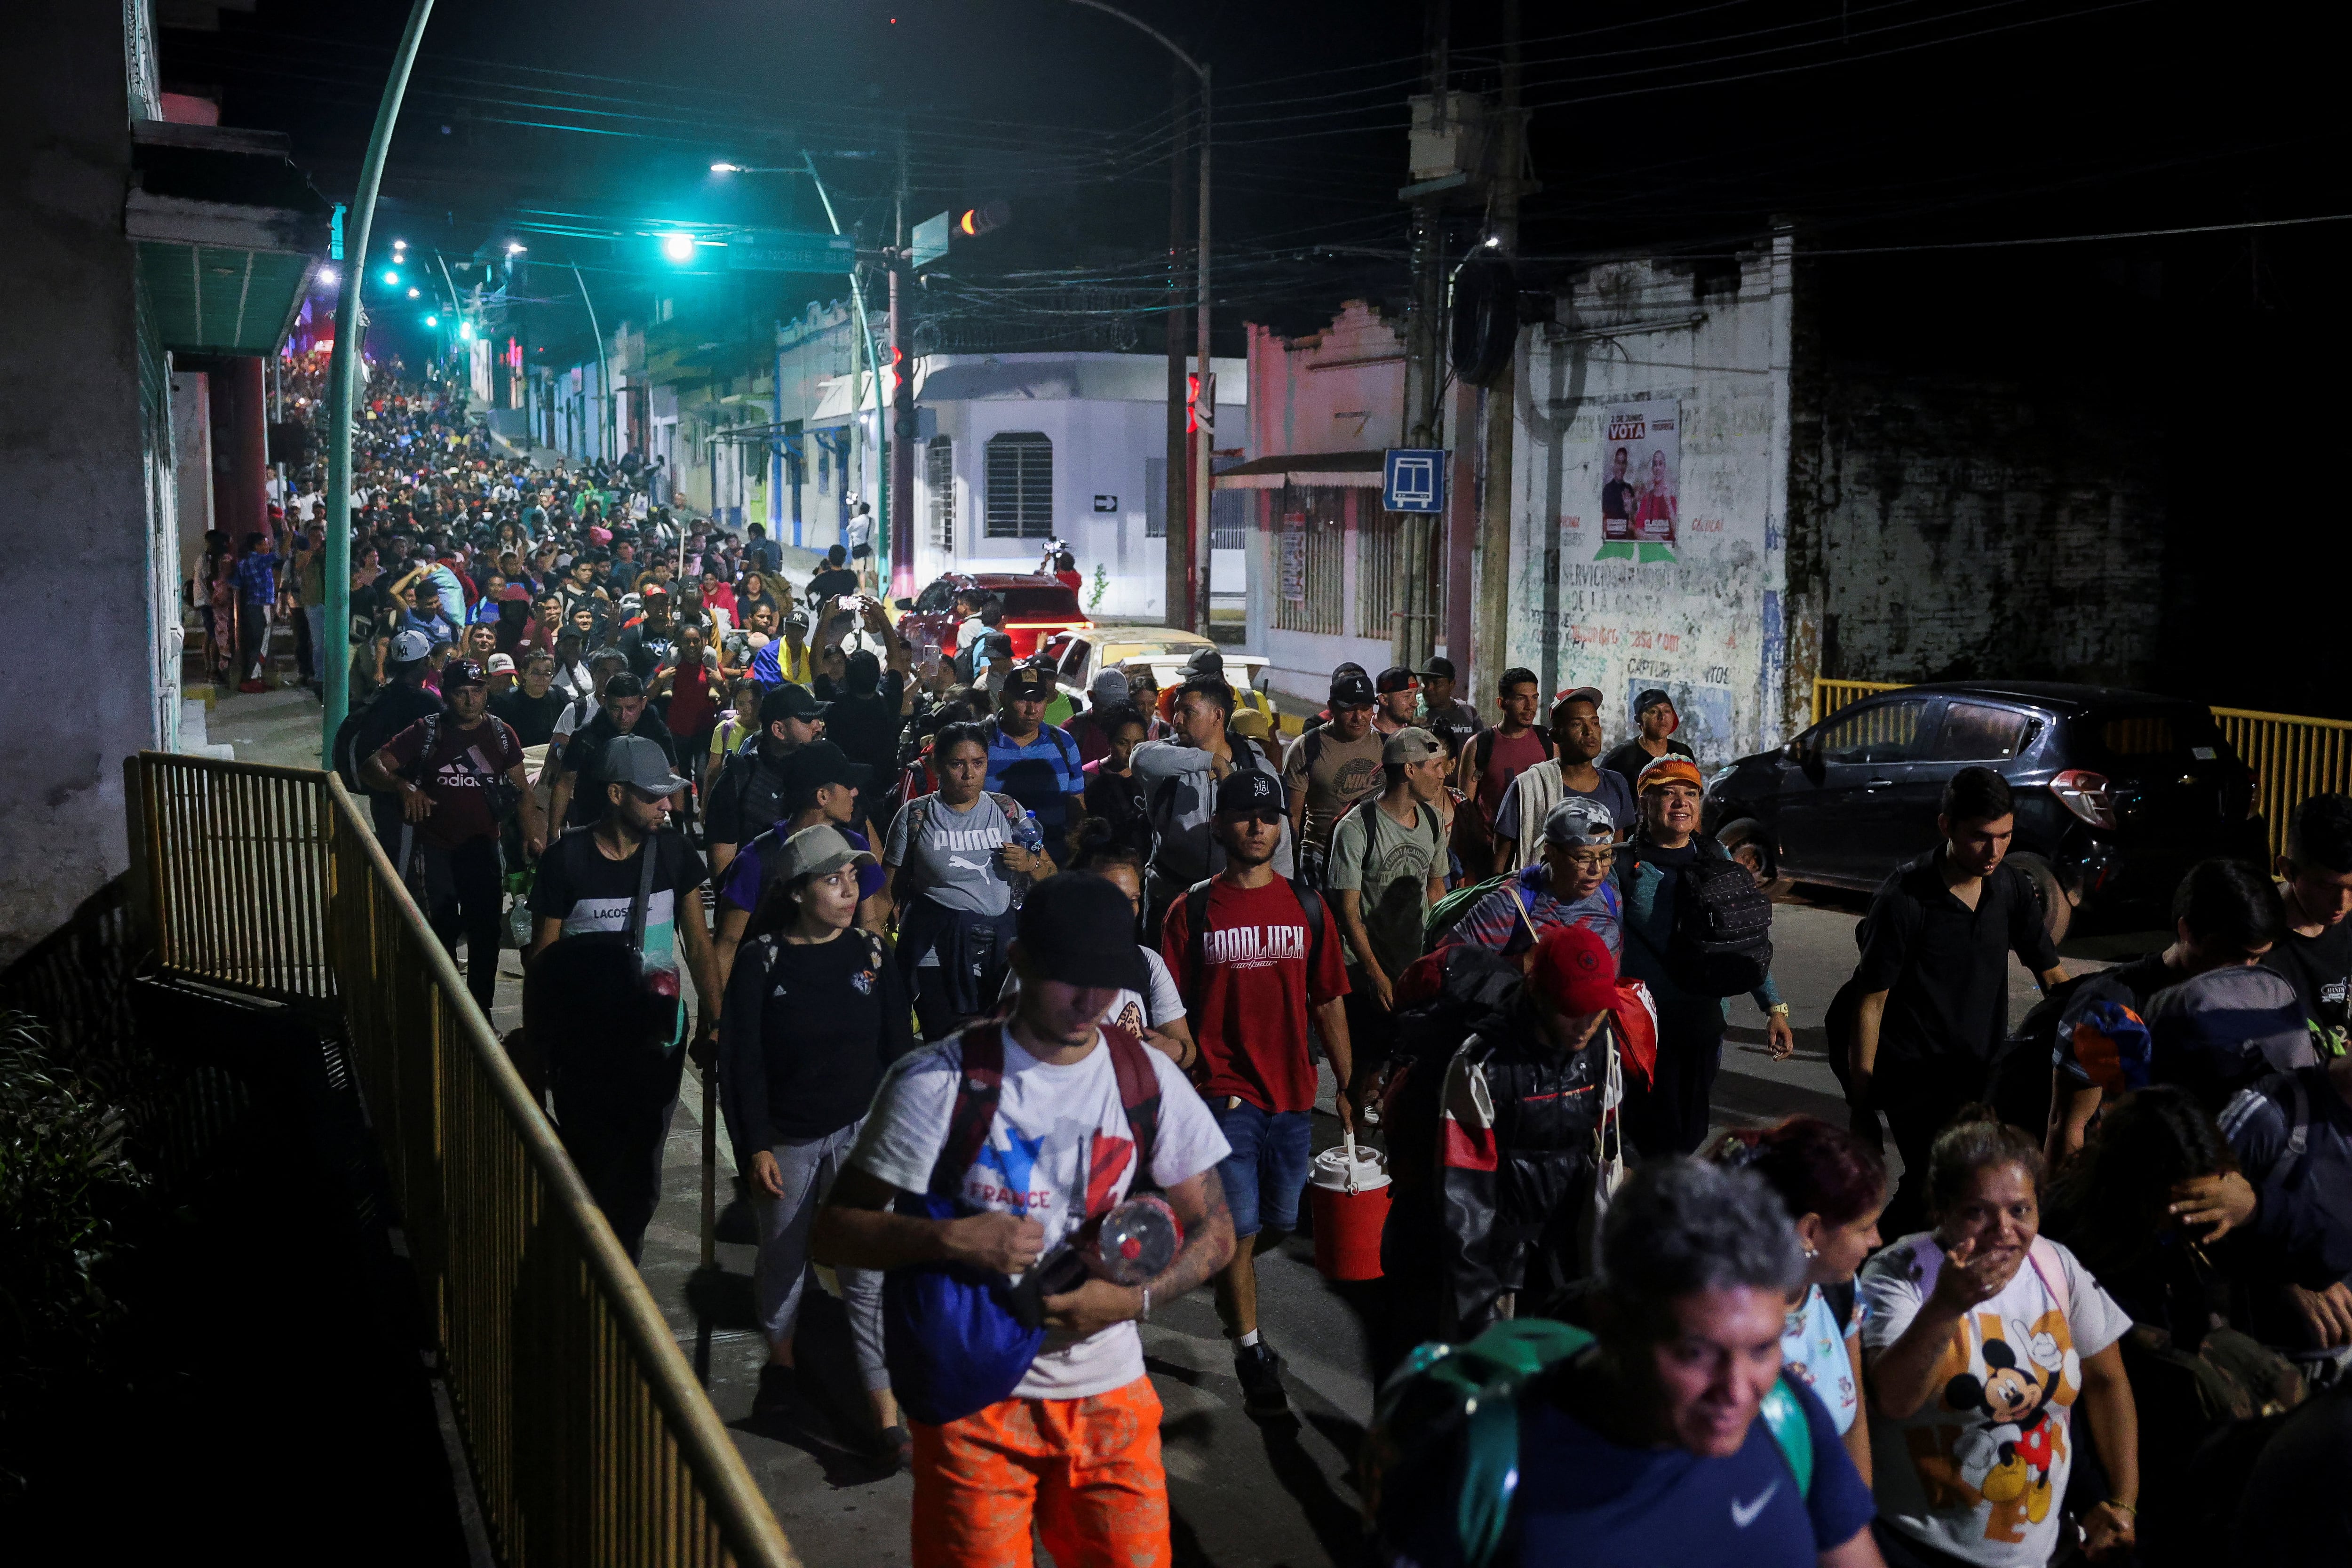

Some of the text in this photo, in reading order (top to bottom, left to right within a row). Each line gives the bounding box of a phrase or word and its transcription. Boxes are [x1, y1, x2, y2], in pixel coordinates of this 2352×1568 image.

[1610, 424, 1644, 439] VOTA
[1343, 773, 1375, 790] NIKE
[934, 827, 1004, 851] PUMA
[594, 906, 638, 919] LACOST
[1203, 925, 1304, 965] GOODLUCK
[969, 1181, 1050, 1209] FRANCE
